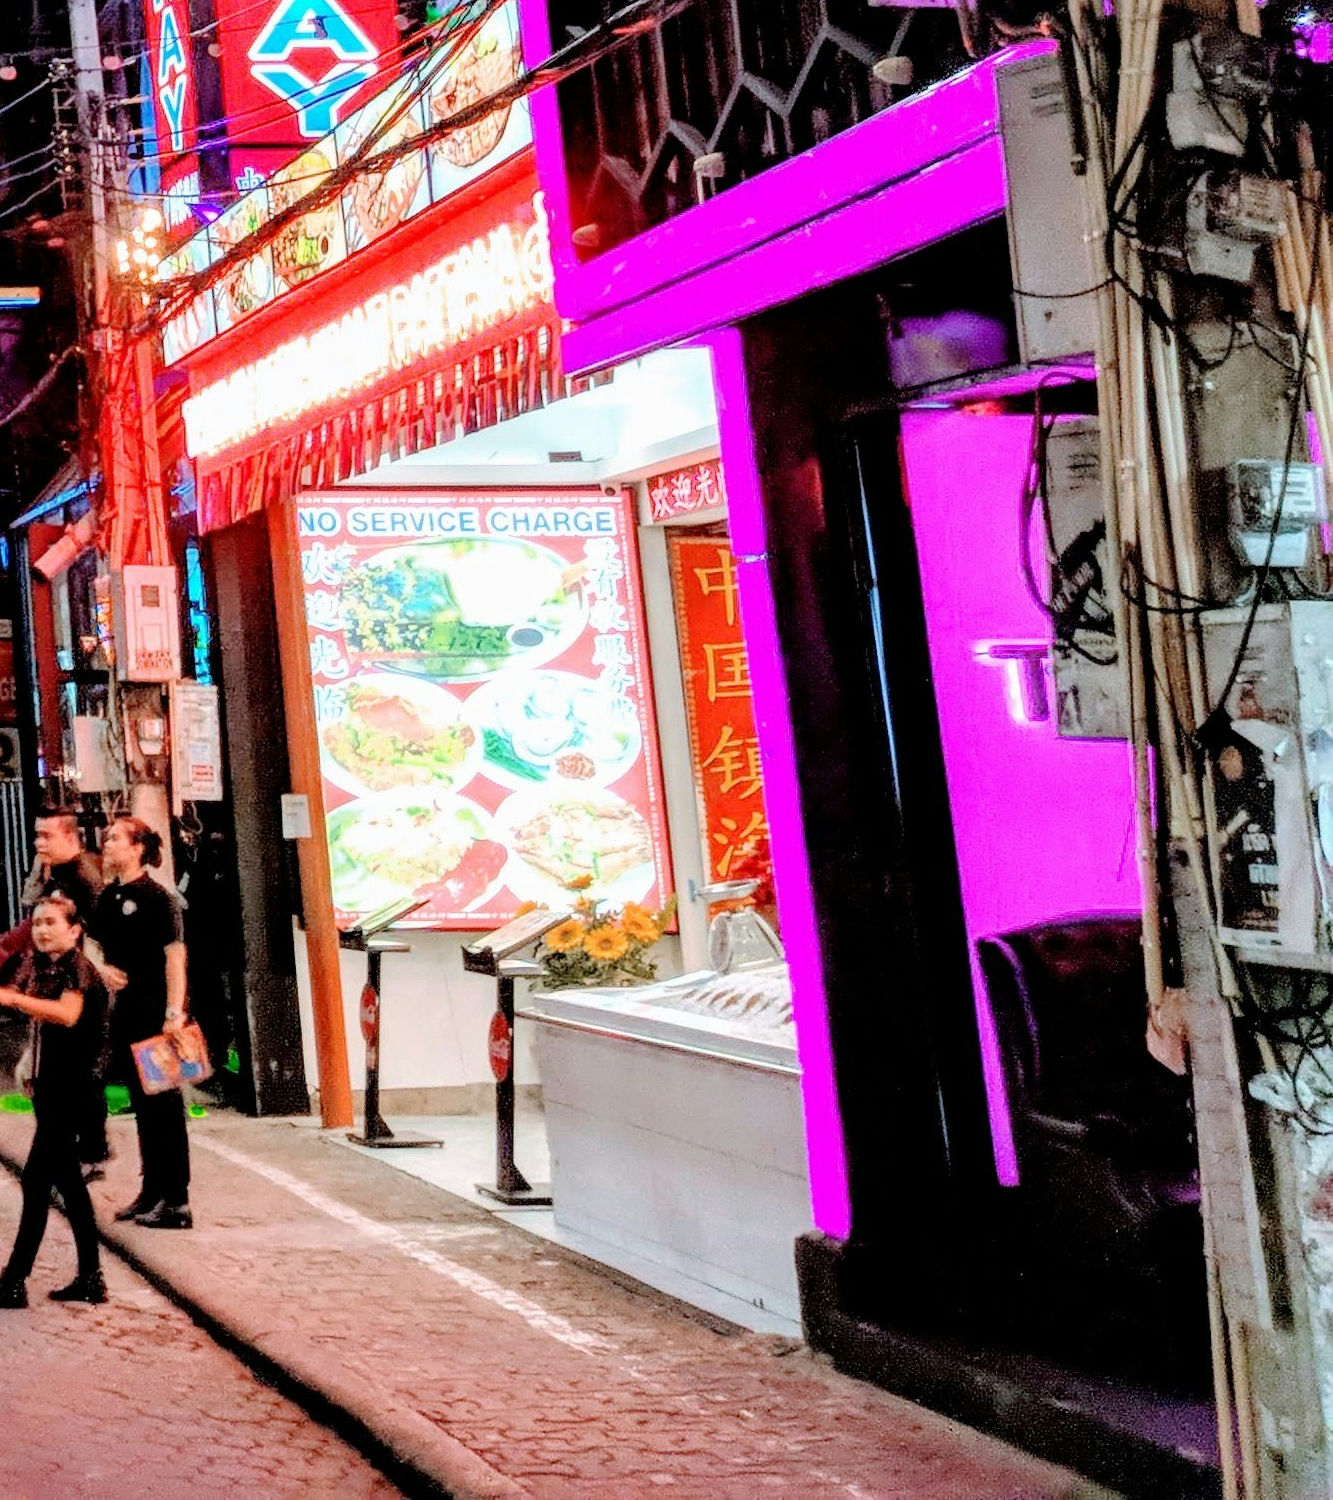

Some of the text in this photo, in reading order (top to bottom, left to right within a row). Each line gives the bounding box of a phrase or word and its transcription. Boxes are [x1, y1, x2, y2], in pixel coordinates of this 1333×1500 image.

[299, 510, 614, 533] NO SERVICE CHARGE
